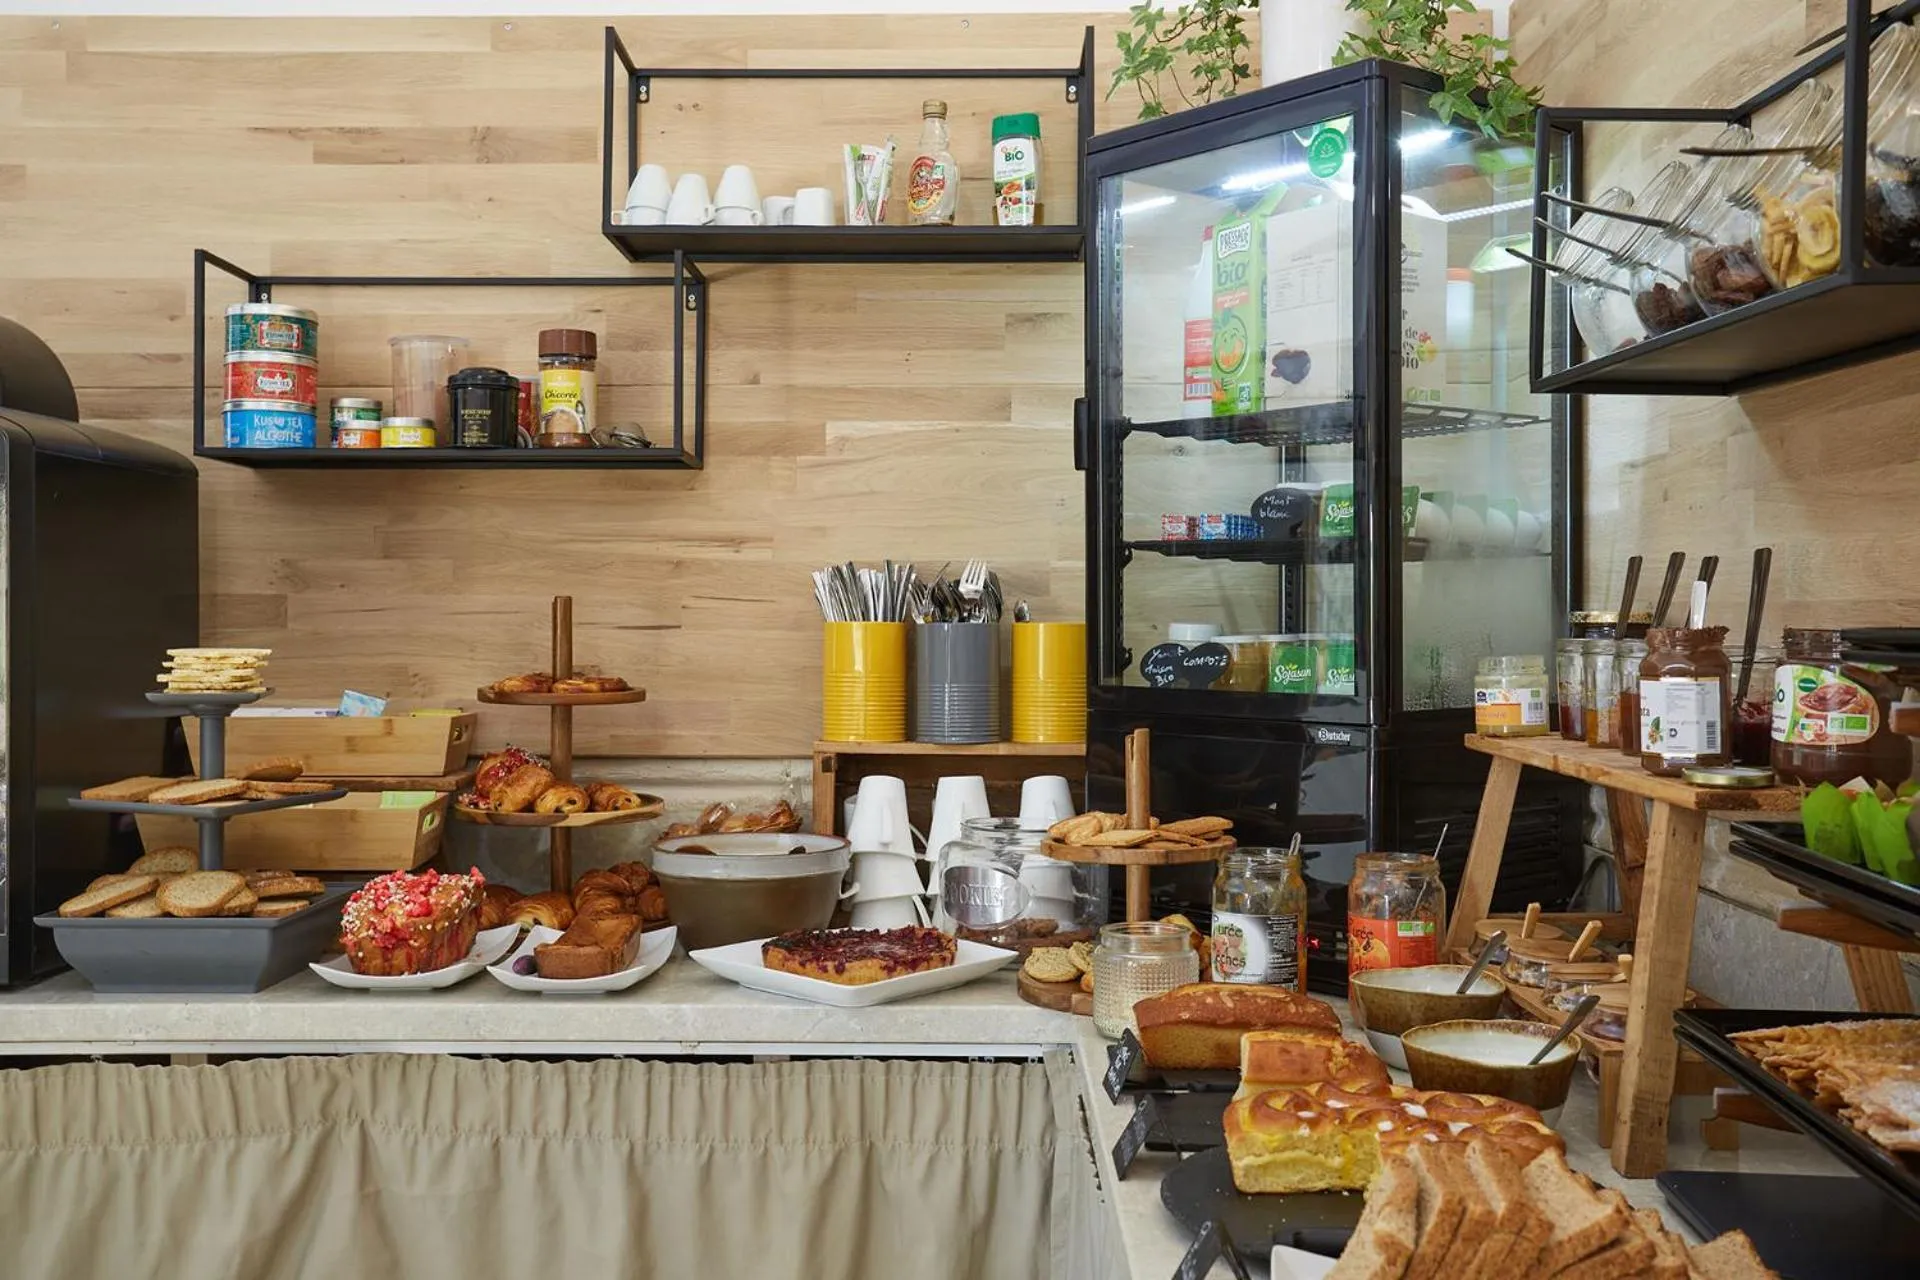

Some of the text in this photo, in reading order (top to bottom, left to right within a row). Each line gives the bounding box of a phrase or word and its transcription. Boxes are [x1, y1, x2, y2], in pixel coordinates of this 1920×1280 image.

[1216, 262, 1246, 287] bio
[1405, 327, 1418, 339] de
[1273, 664, 1312, 685] Sojasun
